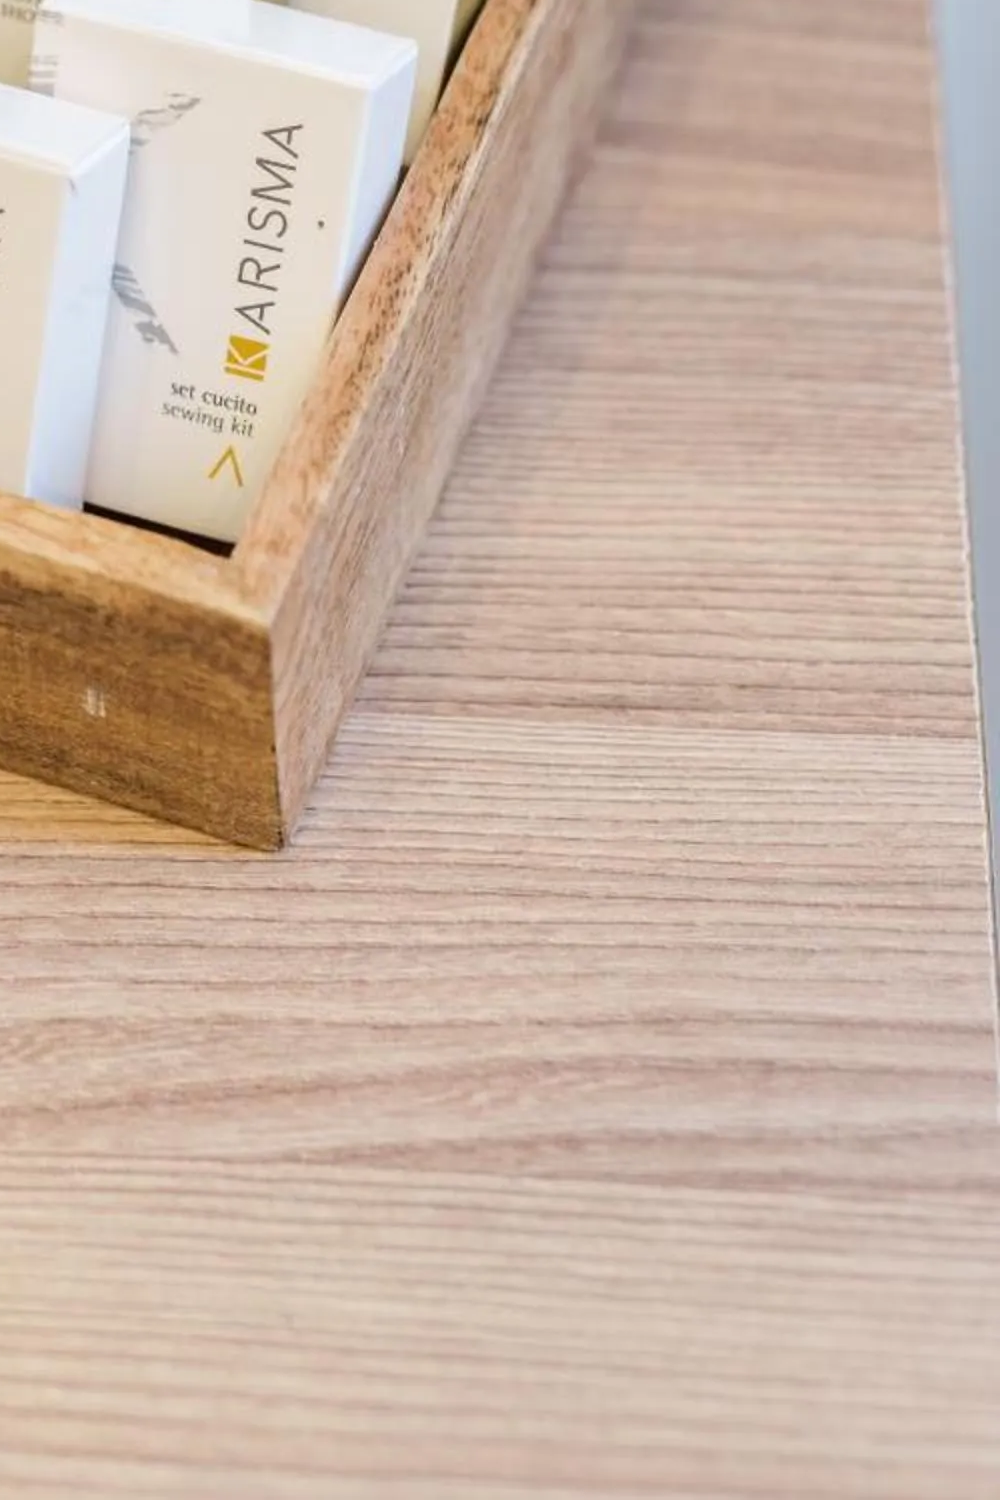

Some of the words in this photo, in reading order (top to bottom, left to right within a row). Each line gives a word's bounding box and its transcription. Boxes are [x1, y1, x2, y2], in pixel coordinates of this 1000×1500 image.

[224, 124, 304, 381] KARISMA
[170, 381, 196, 400] set
[201, 390, 258, 416] cucito
[162, 403, 224, 434] sewing
[232, 416, 256, 438] kit
